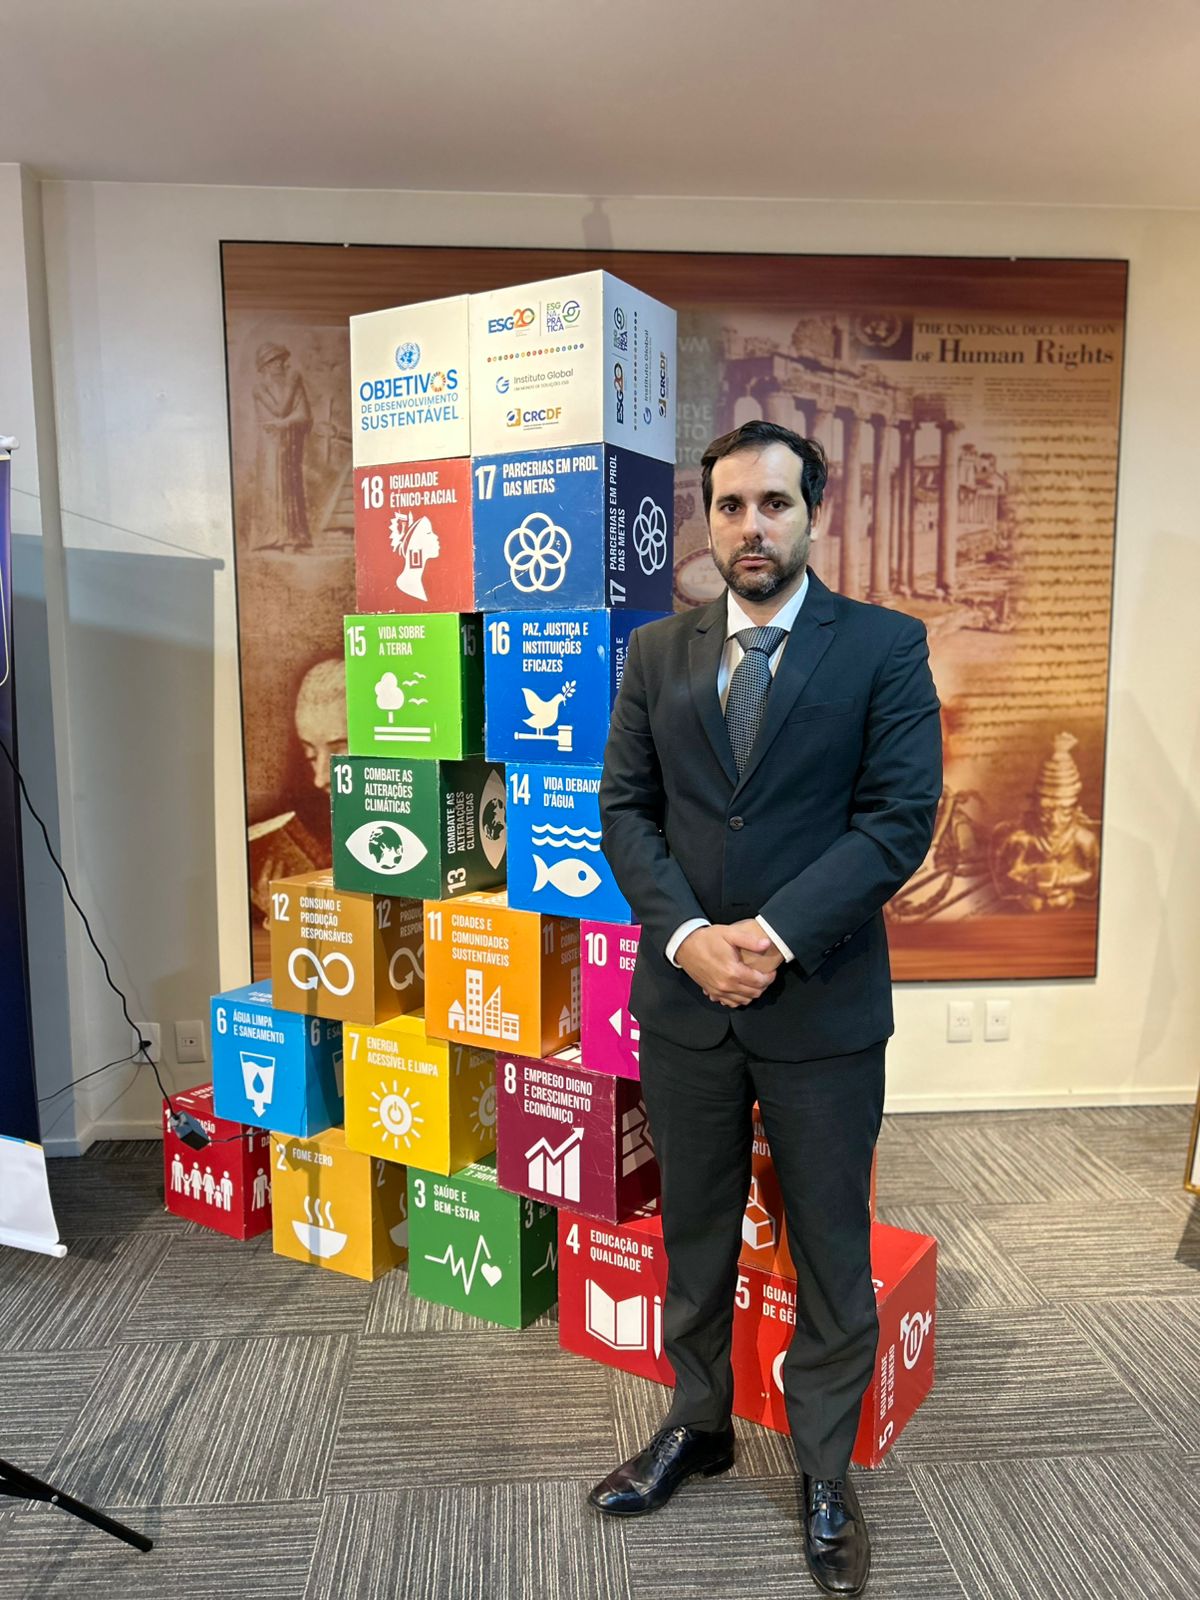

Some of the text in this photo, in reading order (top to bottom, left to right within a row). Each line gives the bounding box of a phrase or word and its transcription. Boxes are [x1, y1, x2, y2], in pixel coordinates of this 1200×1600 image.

[917, 322, 1115, 336] THE UNIVERSAL DECLARATION
[915, 338, 1114, 372] OF Human Rights
[360, 369, 458, 402] OBJETIVOS
[513, 368, 574, 384] Instituto Global
[361, 392, 458, 414] DE DESENVOLVIMENTO
[523, 407, 562, 422] CRCDF
[361, 405, 459, 430] SUSTENTÁVEL
[475, 455, 598, 500] 17 PARCERIAS EM PROL
[609, 454, 617, 485] PROL
[361, 471, 438, 509] 18 IGUALDADE
[390, 489, 457, 508] ÉTNICO-RACIAL
[503, 478, 555, 497] DAS METAS
[609, 487, 617, 505] EM
[618, 508, 626, 572] DAS METAS
[610, 579, 626, 606] 17
[347, 625, 425, 656] 15 VIDA SOBRE
[379, 642, 412, 655] A TERRA
[461, 624, 476, 656] 15
[488, 621, 588, 655] 16 PAZ, JUSTIÇA E
[522, 638, 581, 658] INSTITUIÇÕES
[522, 659, 563, 673] EFICAZES
[334, 764, 412, 794] 13 COMBATE AS
[364, 783, 412, 799] ALTERAÇÕES
[510, 773, 531, 805] 14
[543, 776, 564, 791] VIDA
[365, 797, 411, 814] CLIMÁTICAS
[543, 791, 574, 809] D'ÁGUA
[465, 792, 474, 850] CLIMÁTICAS
[446, 792, 466, 893] 13 COMBATE AS
[272, 893, 341, 921] 12 CONSUMO E
[300, 912, 338, 928] PRODUÇÃO
[376, 899, 391, 929] 12
[301, 927, 353, 944] RESPONSÁVEIS
[427, 911, 492, 941] 11 CIDADES E
[543, 922, 554, 955] 11
[452, 931, 509, 950] COMUNIDADES
[584, 933, 639, 967] 10 RED
[452, 947, 509, 967] SUSTENTÁVEIS
[216, 1007, 272, 1034] 6 ÁGUA LIMPA
[311, 1019, 320, 1046] 6
[234, 1025, 284, 1044] E SANEAMENTO
[349, 1032, 360, 1061] 7
[367, 1036, 398, 1053] ENERGIA
[367, 1052, 439, 1077] ACESSÍVEL E LIMPA
[504, 1063, 592, 1096] 8 EMPREGO DIGNO
[524, 1084, 591, 1112] E CRESCIMENTO
[524, 1099, 573, 1124] ECONÔMICO
[276, 1144, 333, 1171] 2 FOME ZERO
[376, 1160, 385, 1187] 2
[414, 1179, 467, 1208] 3 SAÚDE E
[434, 1201, 480, 1222] BEM-ESTAR
[524, 1200, 533, 1228] 3
[566, 1224, 654, 1259] 4 EDUCAÇÃO DE
[590, 1246, 641, 1273] QUALIDADE
[735, 1275, 796, 1310] 5 IGUAL
[763, 1302, 796, 1326] DE GÊ
[887, 1344, 895, 1409] DE GÊNERO
[878, 1353, 894, 1450] 5 IGUALDADE
